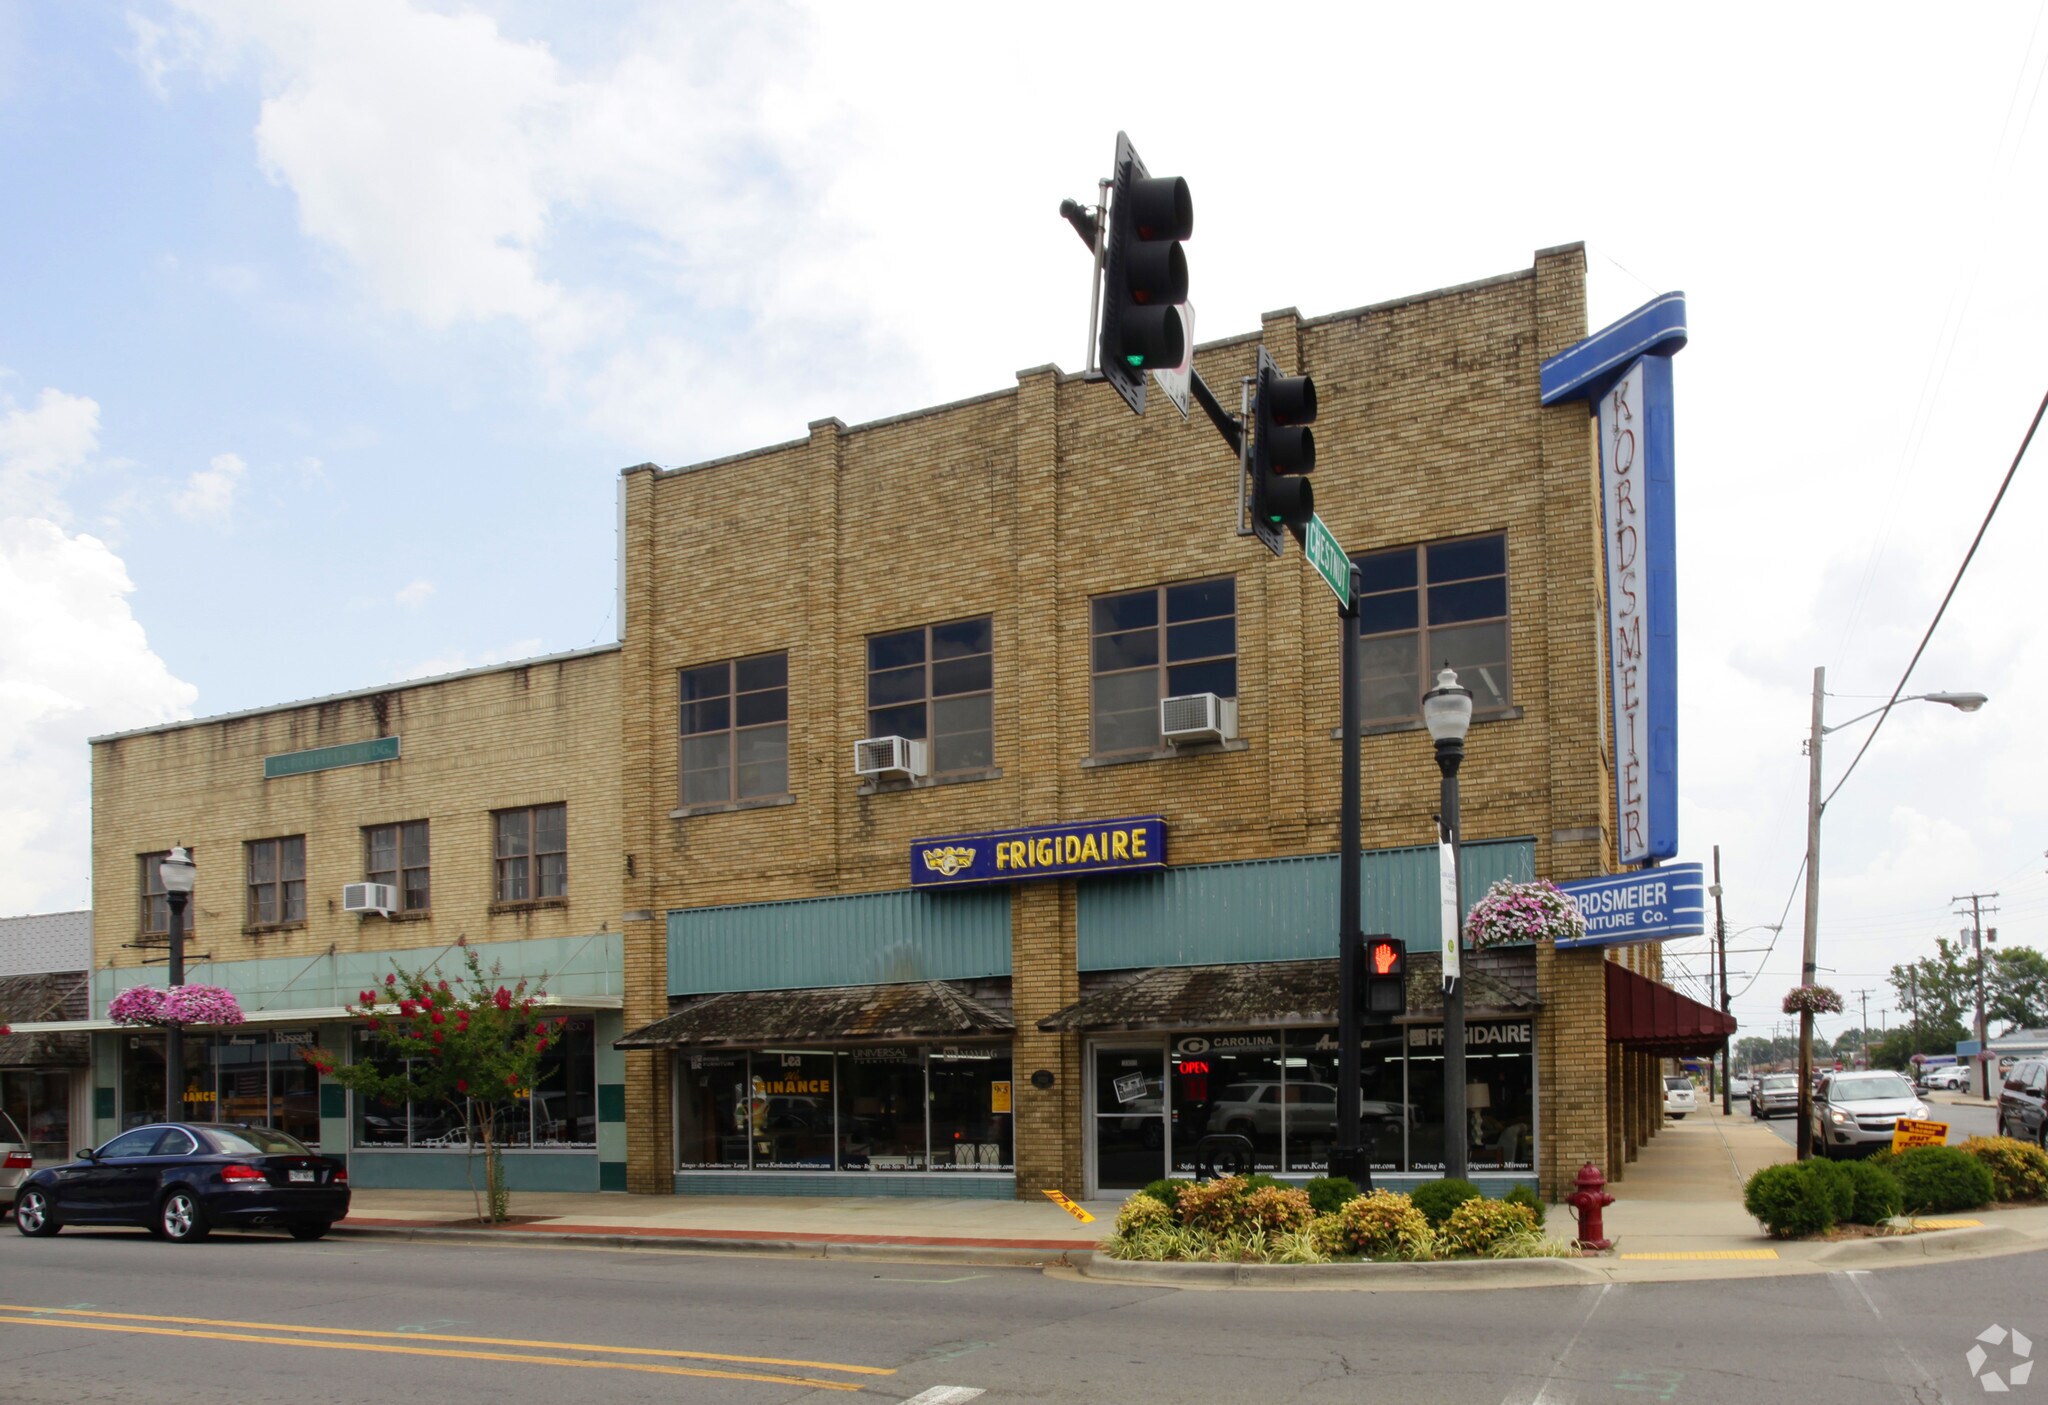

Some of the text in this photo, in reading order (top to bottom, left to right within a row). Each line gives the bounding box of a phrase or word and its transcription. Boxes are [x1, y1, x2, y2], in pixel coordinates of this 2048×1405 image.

[1310, 522, 1346, 592] CHESTNUT
[1613, 381, 1644, 856] KORDSMEIER
[996, 828, 1147, 871] FRIGIDAIRE
[1571, 882, 1667, 915] ORDSMEIER
[1584, 910, 1668, 931] NITURE Co.
[275, 1031, 314, 1044] Bassett
[1214, 1036, 1274, 1047] CAROLINA
[1316, 1034, 1370, 1050] Ama
[1428, 1024, 1530, 1046] FRIDAIRE
[780, 1053, 801, 1067] Lea
[853, 1048, 907, 1058] UNIVERSAL
[1179, 1061, 1209, 1075] OPEN
[756, 1080, 830, 1094] FINANCE
[1467, 1162, 1500, 1171] frigerators
